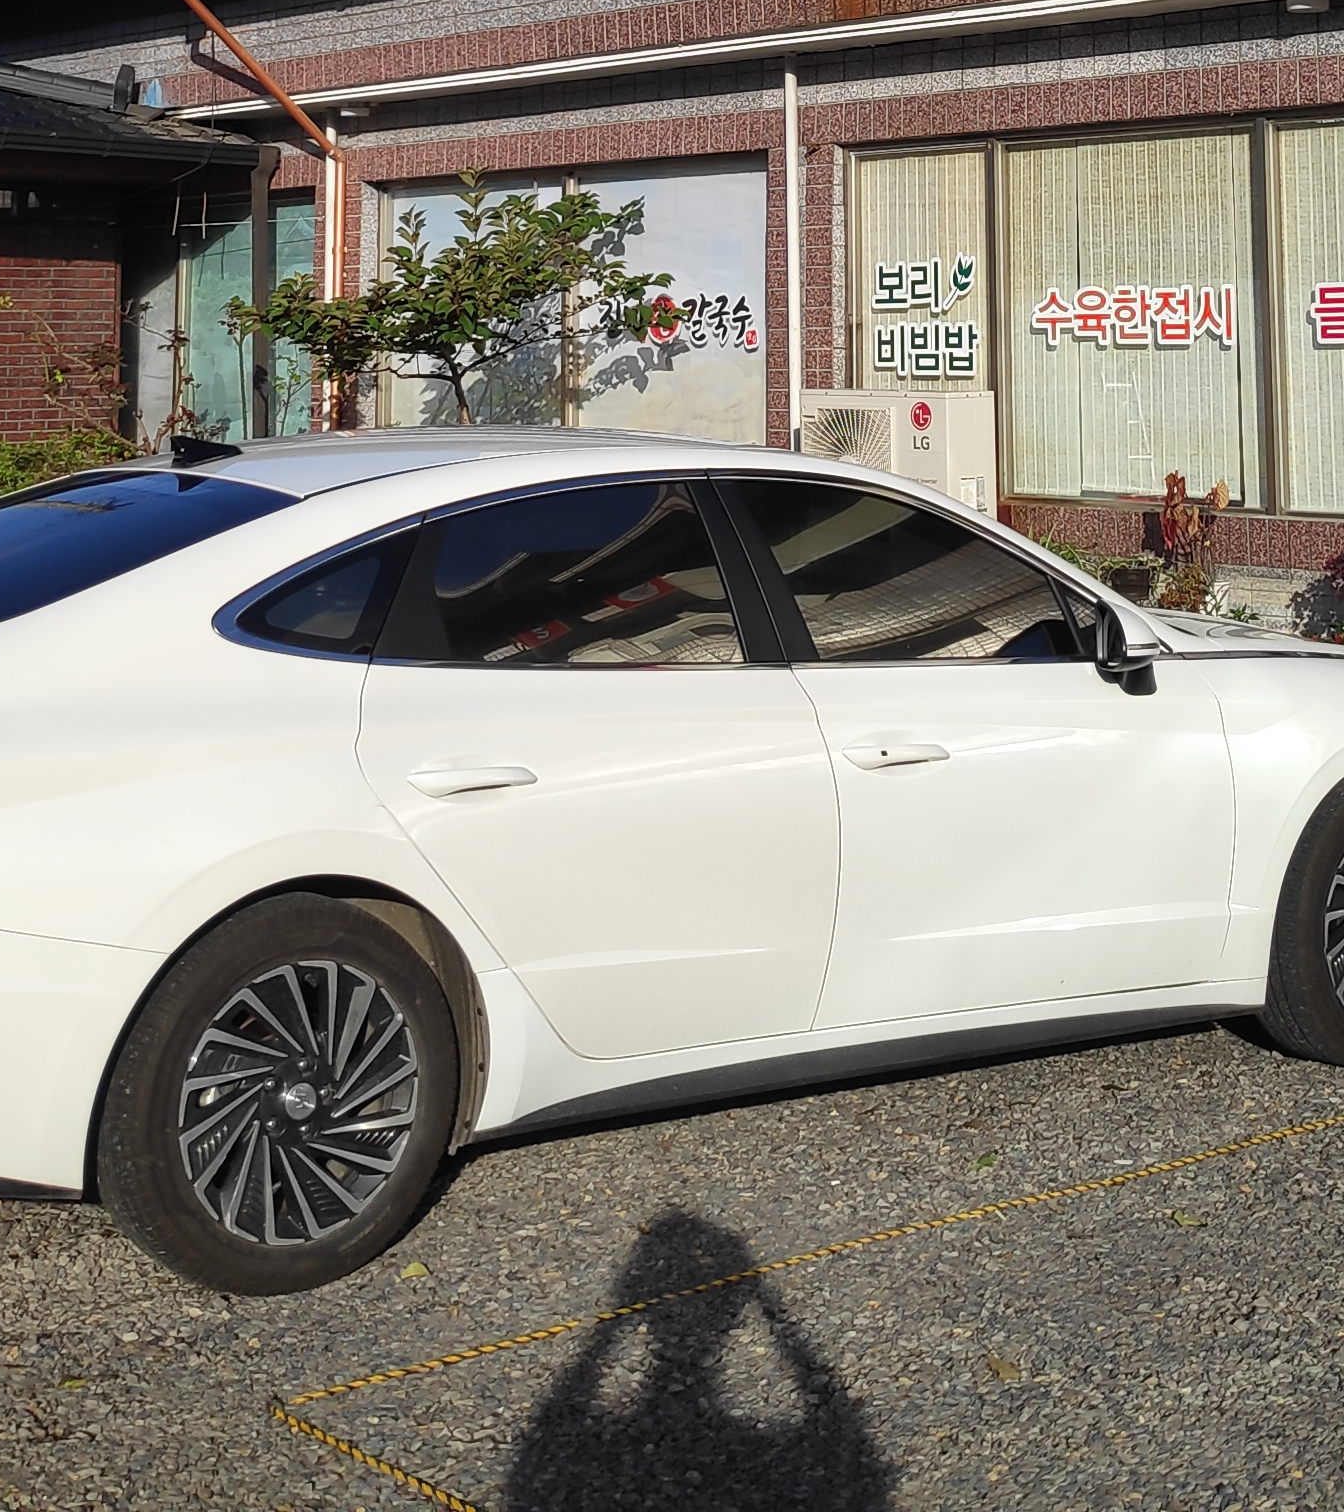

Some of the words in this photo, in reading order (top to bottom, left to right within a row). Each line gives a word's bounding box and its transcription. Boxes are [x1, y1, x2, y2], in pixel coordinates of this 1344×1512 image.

[874, 260, 939, 308] 보리
[1035, 288, 1233, 341] 수육한접시
[877, 324, 977, 371] 비빔밥
[913, 435, 930, 450] LG
